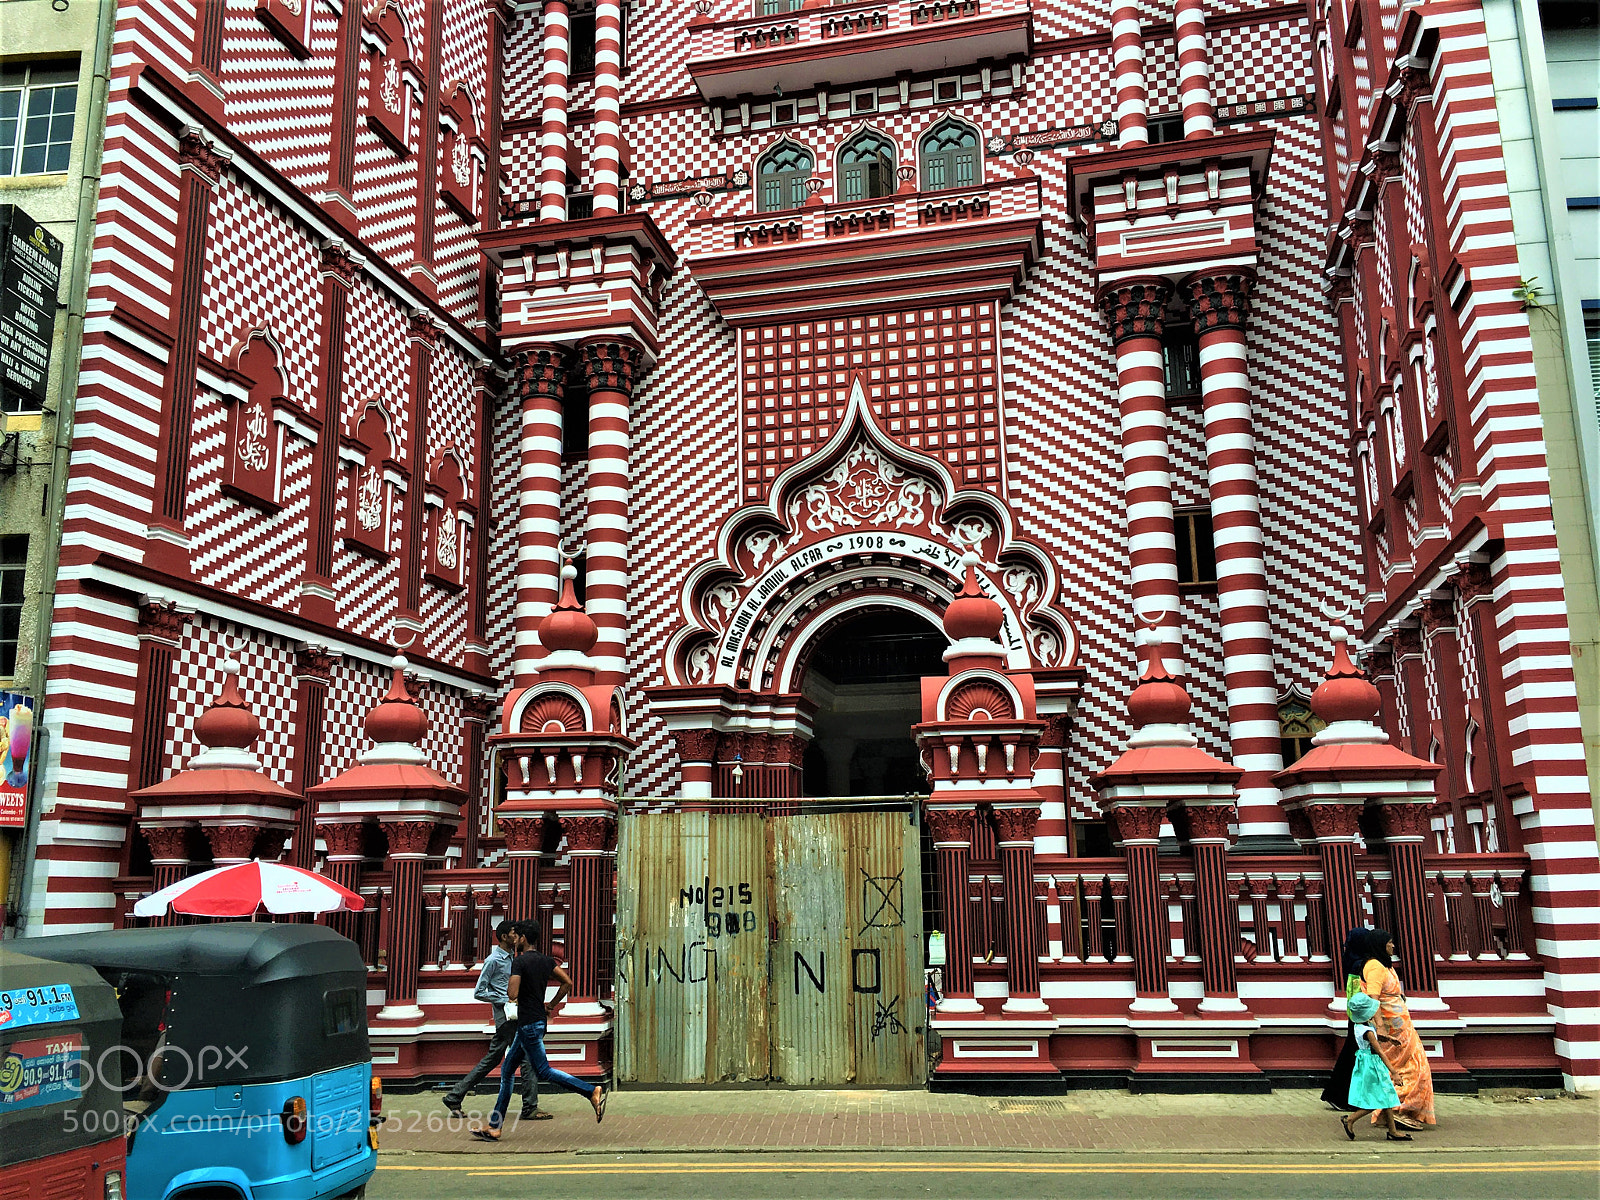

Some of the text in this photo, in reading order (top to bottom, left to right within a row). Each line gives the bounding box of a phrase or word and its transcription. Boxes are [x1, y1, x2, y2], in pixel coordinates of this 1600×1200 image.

[12, 234, 38, 261] CAREEM
[39, 254, 59, 276] LANKA
[17, 280, 44, 306] TICKETING
[22, 273, 42, 293] AIRLINE
[14, 311, 39, 333] BOOKING
[20, 302, 36, 320] HOTEL
[0, 320, 48, 357] VISA PROCESSING
[10, 339, 22, 353] ANY
[22, 347, 47, 369] COUNTRY
[0, 352, 41, 383] HAJJ & UMRAH
[6, 367, 33, 390] SERVICES
[848, 536, 884, 550] 1908
[721, 547, 824, 667] AL MASJIDH AL JAMIUL ALFAR
[712, 883, 752, 907] 215
[794, 948, 881, 994] NO
[45, 1041, 73, 1055] TAXI
[23, 1067, 43, 1087] 90.9
[4, 1094, 14, 1102] FM
